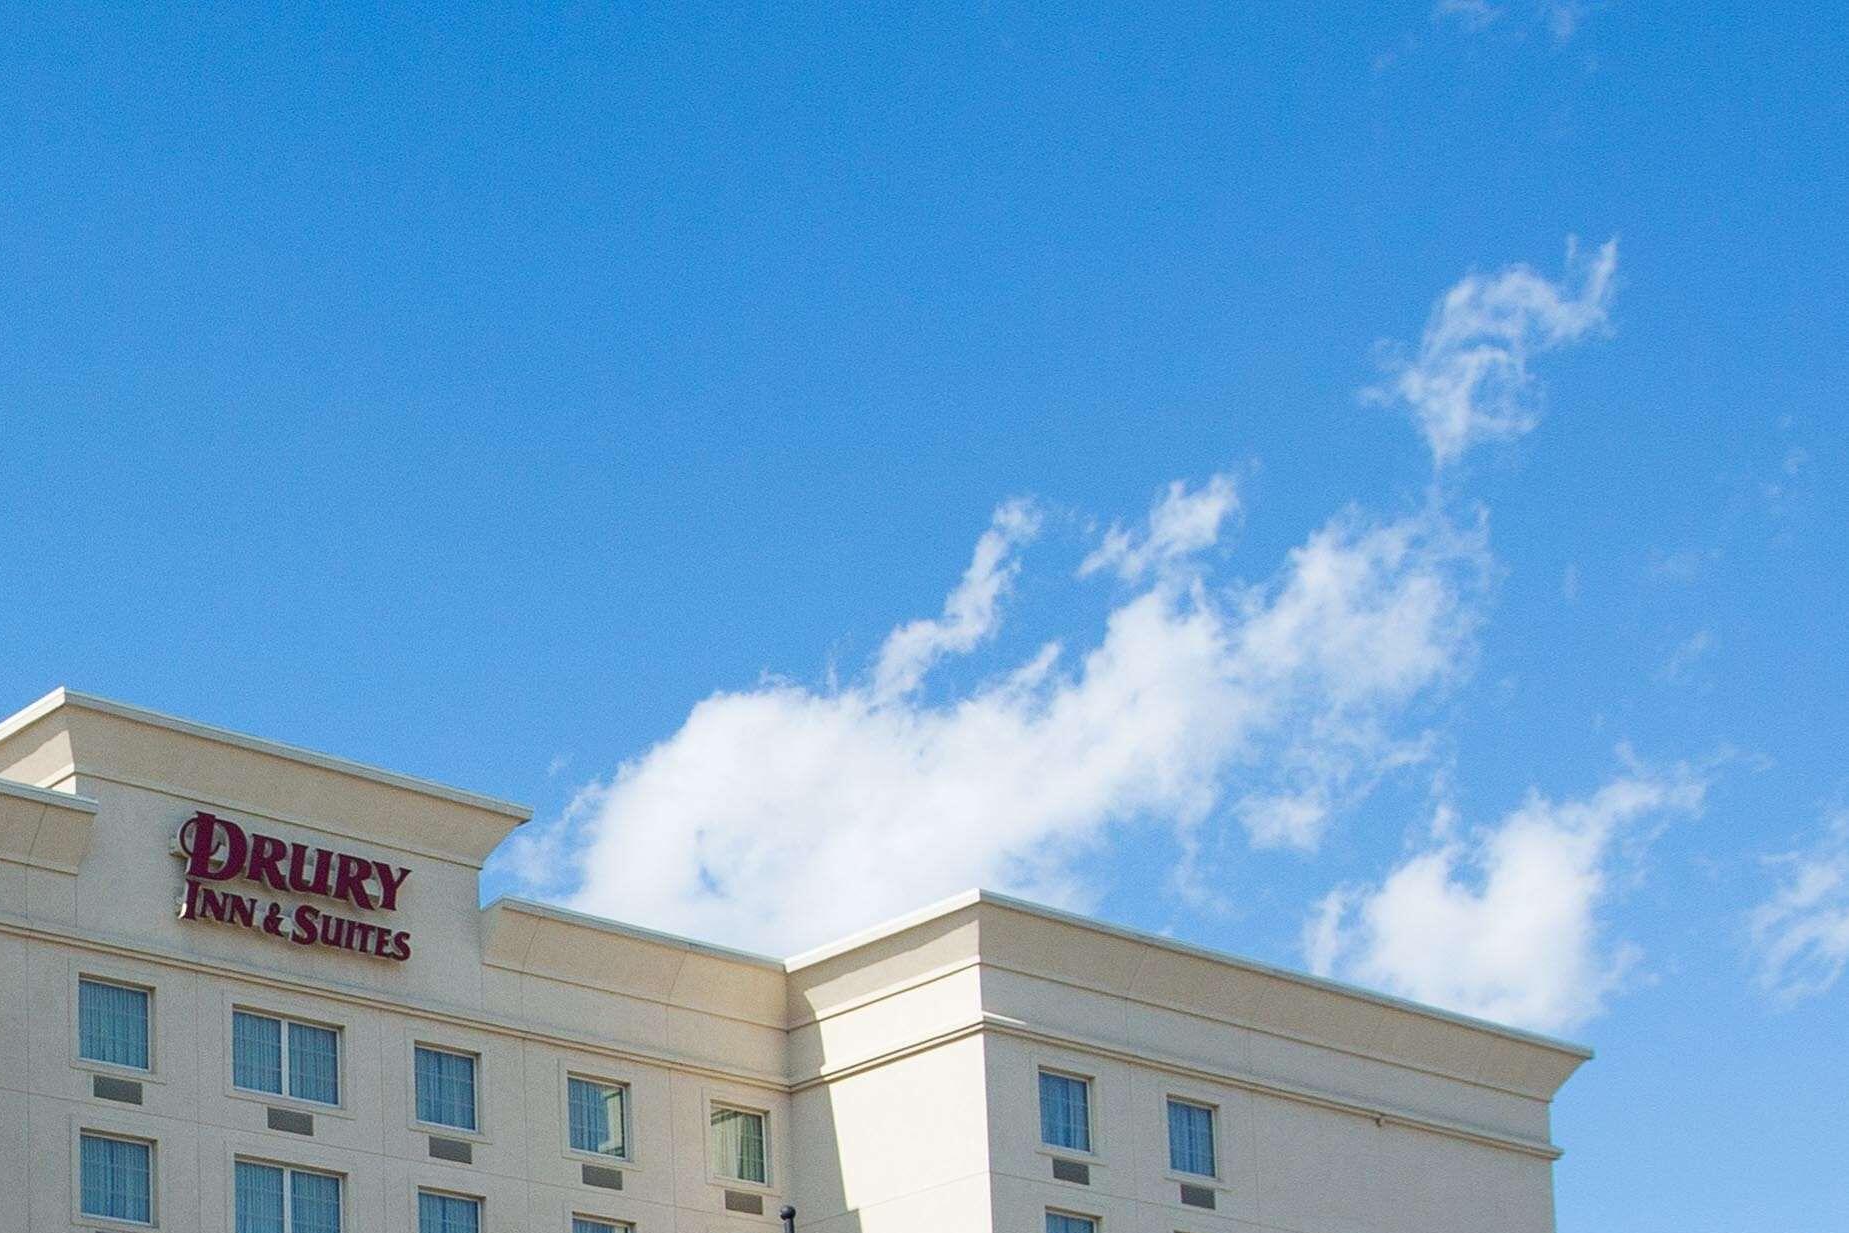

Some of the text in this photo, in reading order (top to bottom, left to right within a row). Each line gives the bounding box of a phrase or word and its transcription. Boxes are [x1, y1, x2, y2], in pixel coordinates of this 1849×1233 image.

[178, 810, 412, 911] DRURY
[181, 878, 412, 962] INN & SUITES
